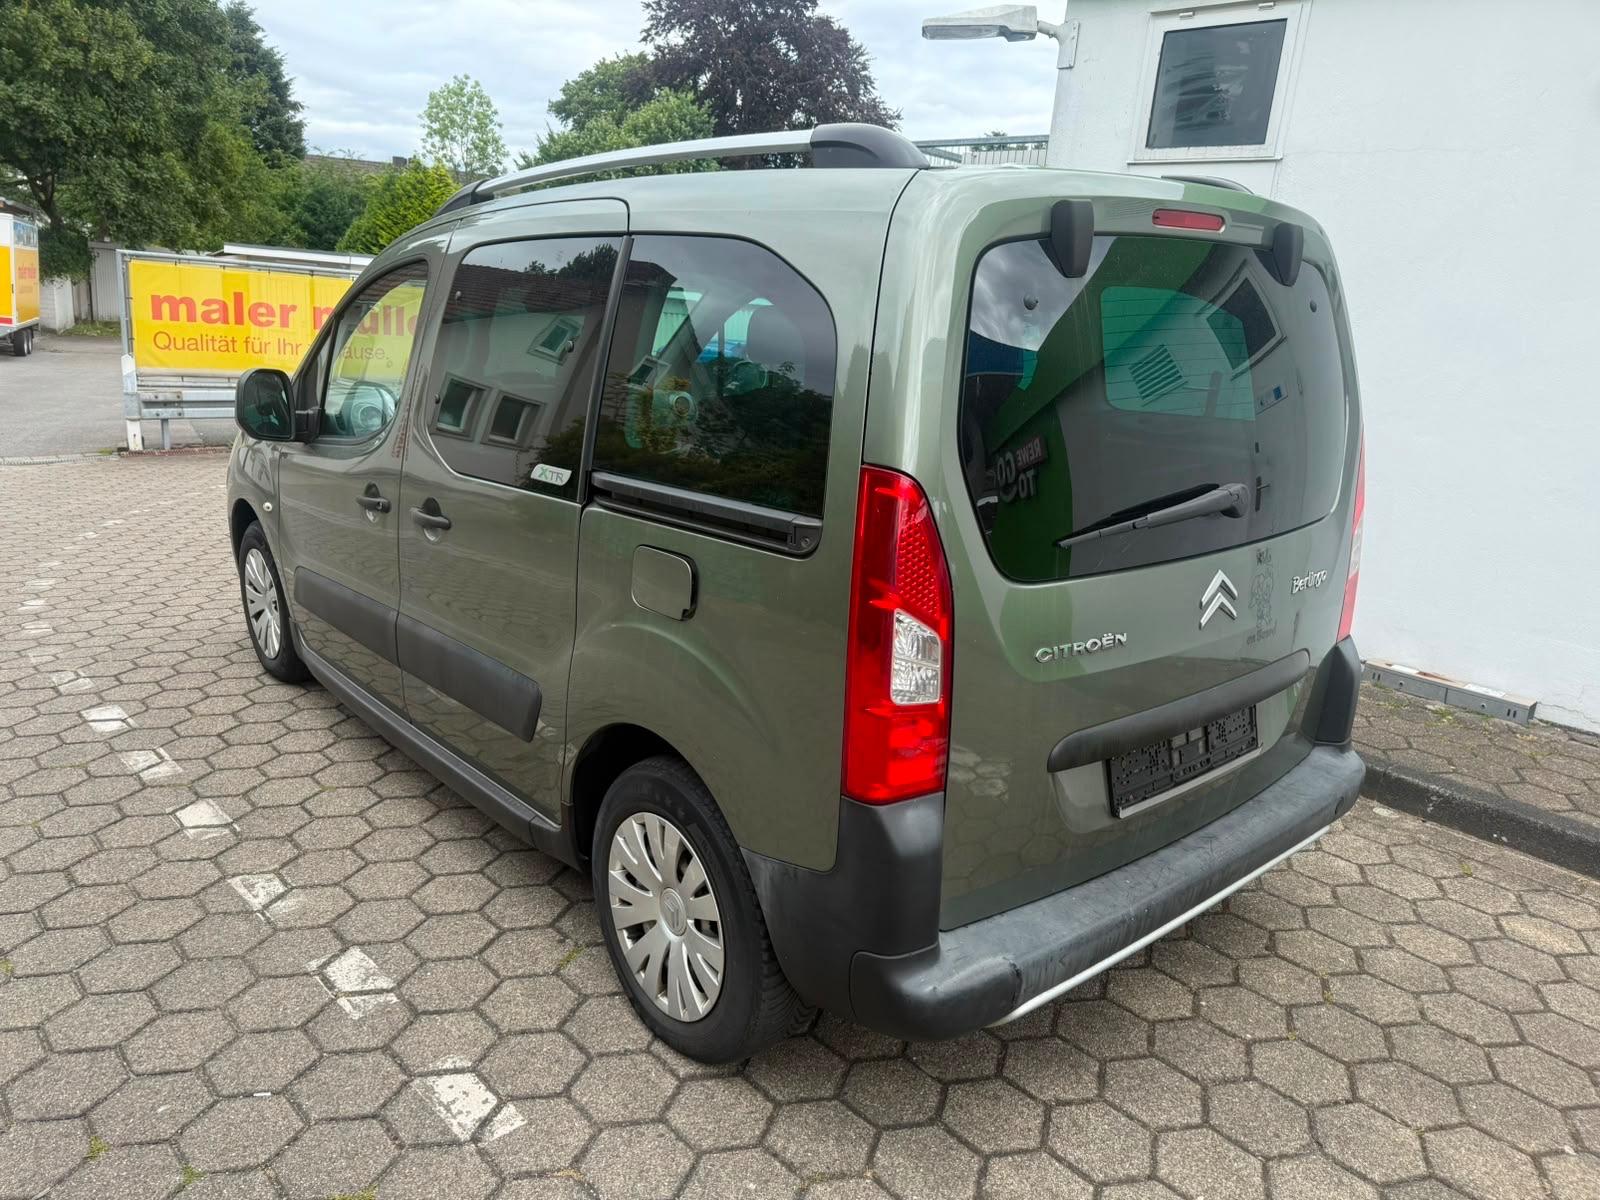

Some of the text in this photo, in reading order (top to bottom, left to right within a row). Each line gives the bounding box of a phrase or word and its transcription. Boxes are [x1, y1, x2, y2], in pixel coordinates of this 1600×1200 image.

[150, 291, 298, 329] maler
[153, 330, 238, 354] Qualität
[243, 335, 271, 355] für
[277, 337, 302, 356] Ihr
[538, 466, 564, 483] XTR
[1291, 569, 1327, 594] Berlingo
[1034, 632, 1128, 663] CITROËN
